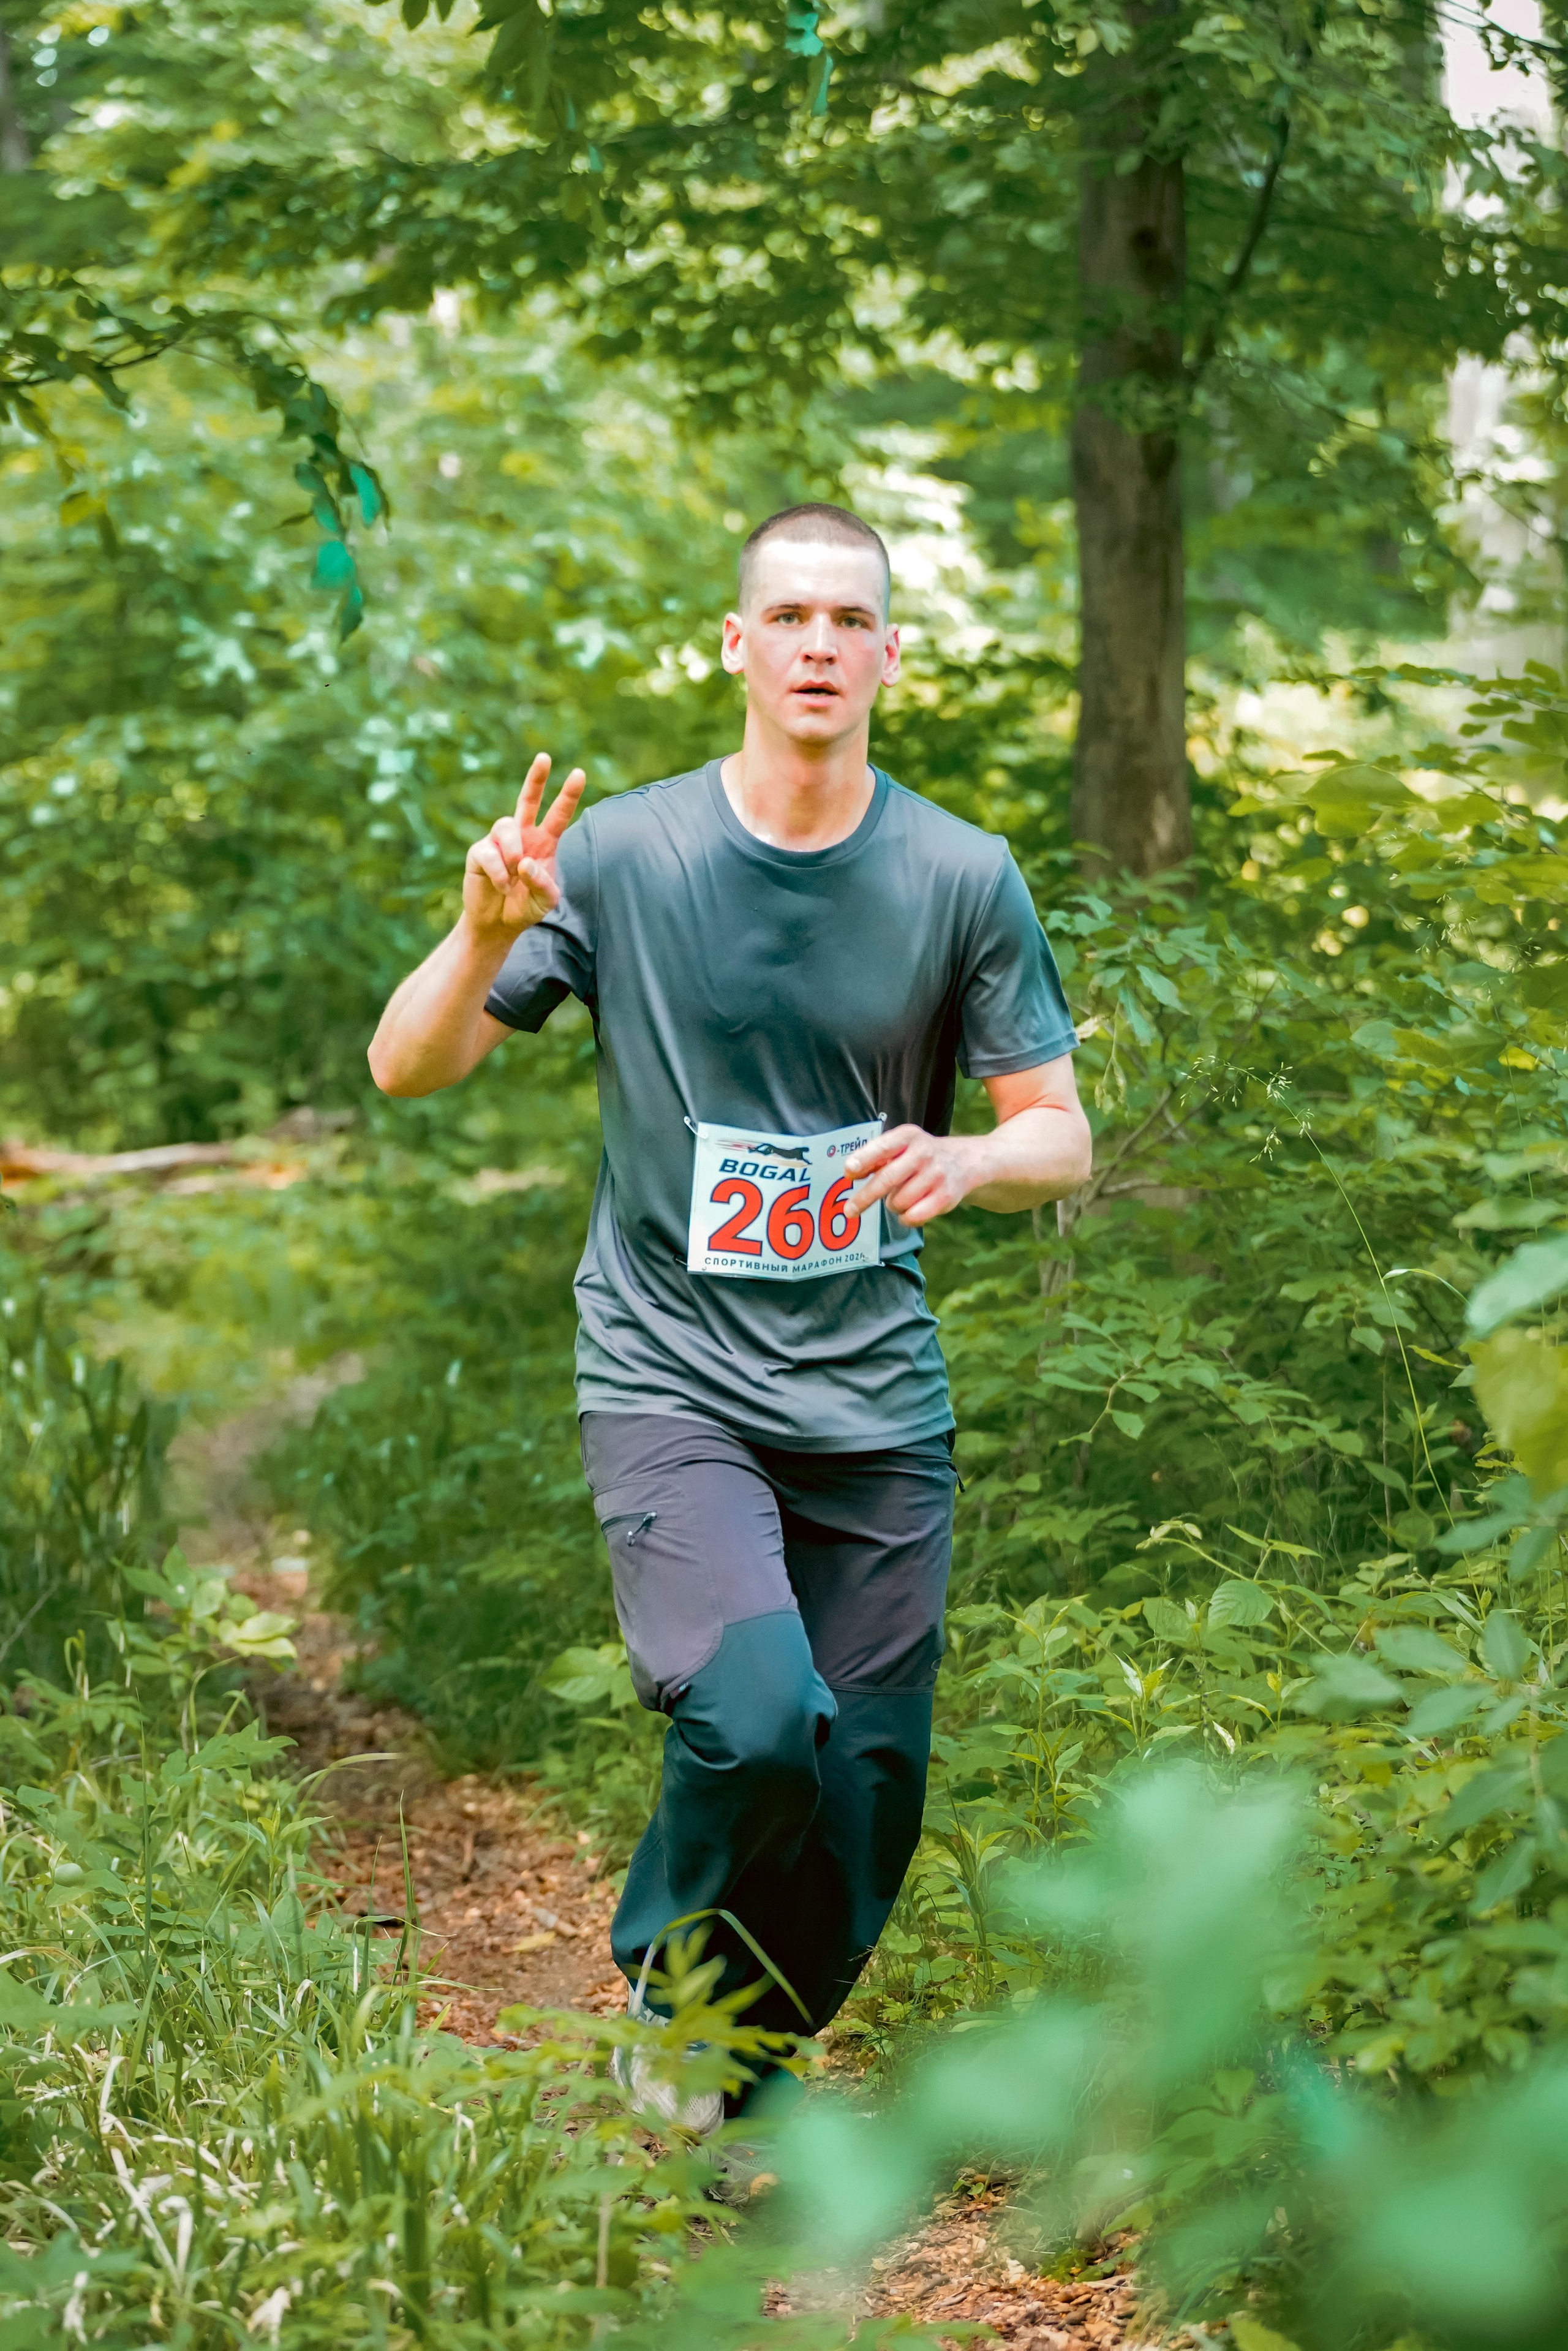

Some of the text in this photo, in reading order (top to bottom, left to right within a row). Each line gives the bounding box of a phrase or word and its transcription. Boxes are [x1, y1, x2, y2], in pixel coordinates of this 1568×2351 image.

[719, 1158, 811, 1182] BOGAL
[707, 1176, 861, 1260] 266
[704, 1257, 788, 1272] СПОРТИВНЫЙ
[792, 1256, 842, 1273] МАРАФОН
